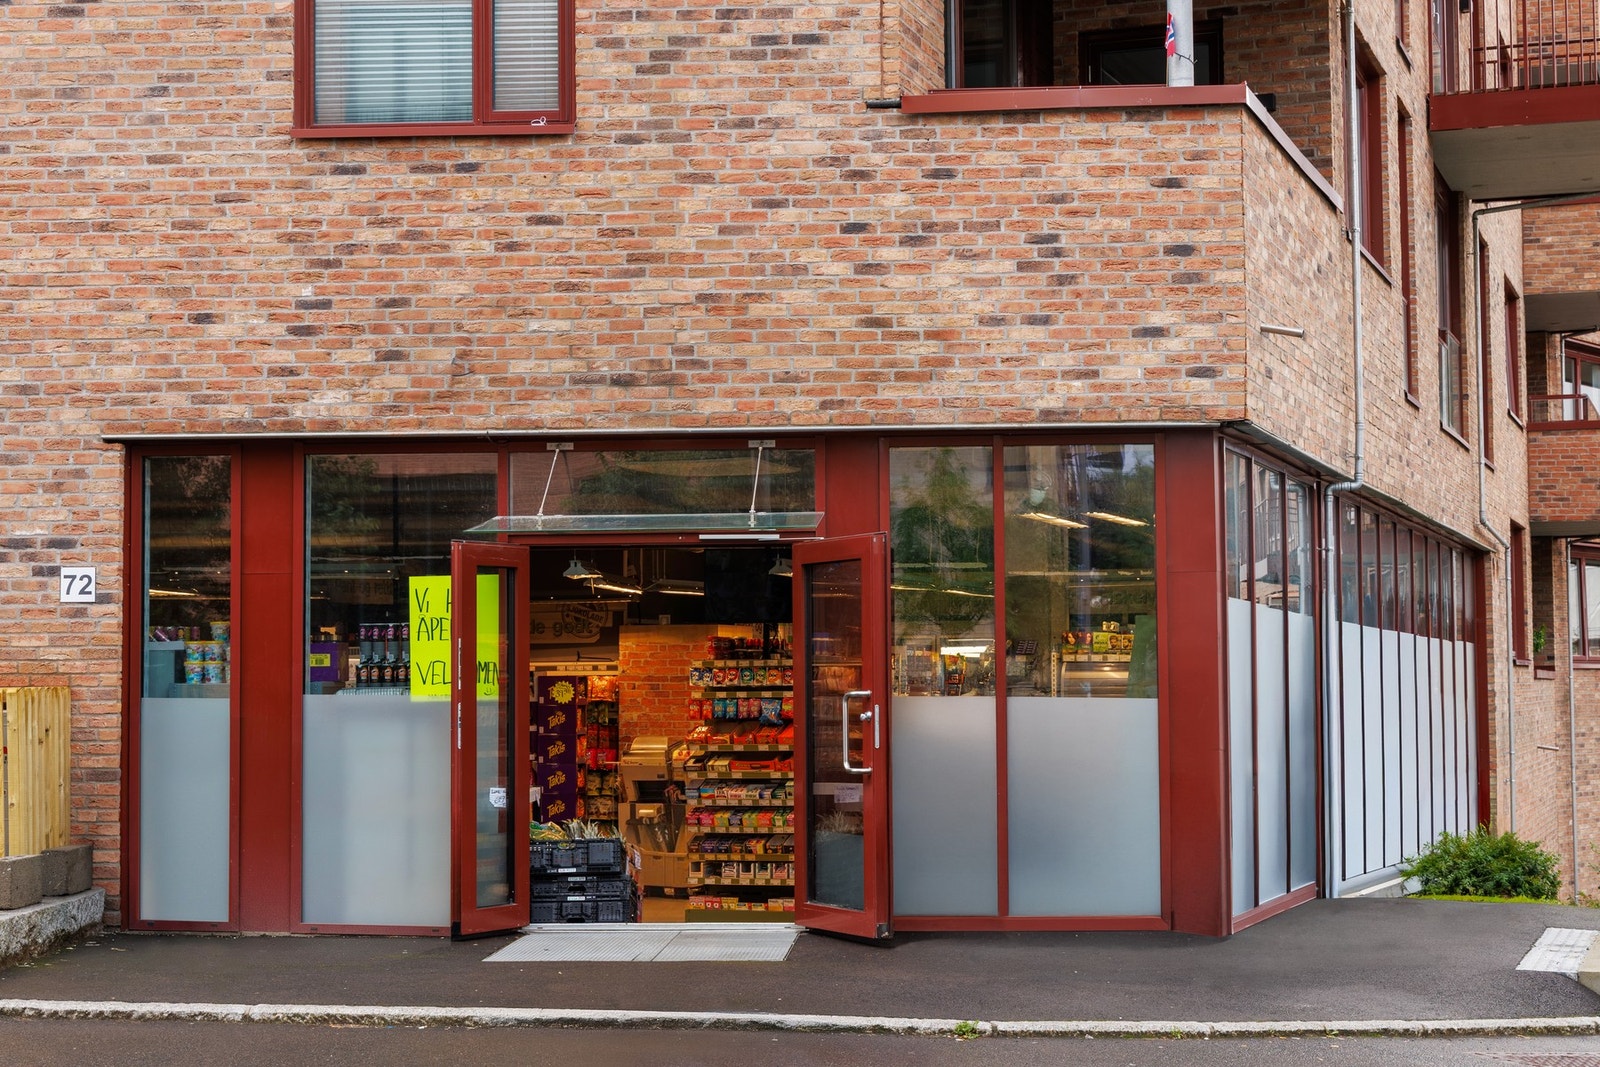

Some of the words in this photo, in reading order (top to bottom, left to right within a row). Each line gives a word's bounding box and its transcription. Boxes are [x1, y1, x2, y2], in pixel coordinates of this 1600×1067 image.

[63, 574, 93, 595] 72
[415, 613, 451, 642] ÅPE
[547, 712, 566, 730] Takis
[547, 743, 566, 760] Takis
[547, 772, 566, 790] Takis
[546, 802, 566, 819] Takis
